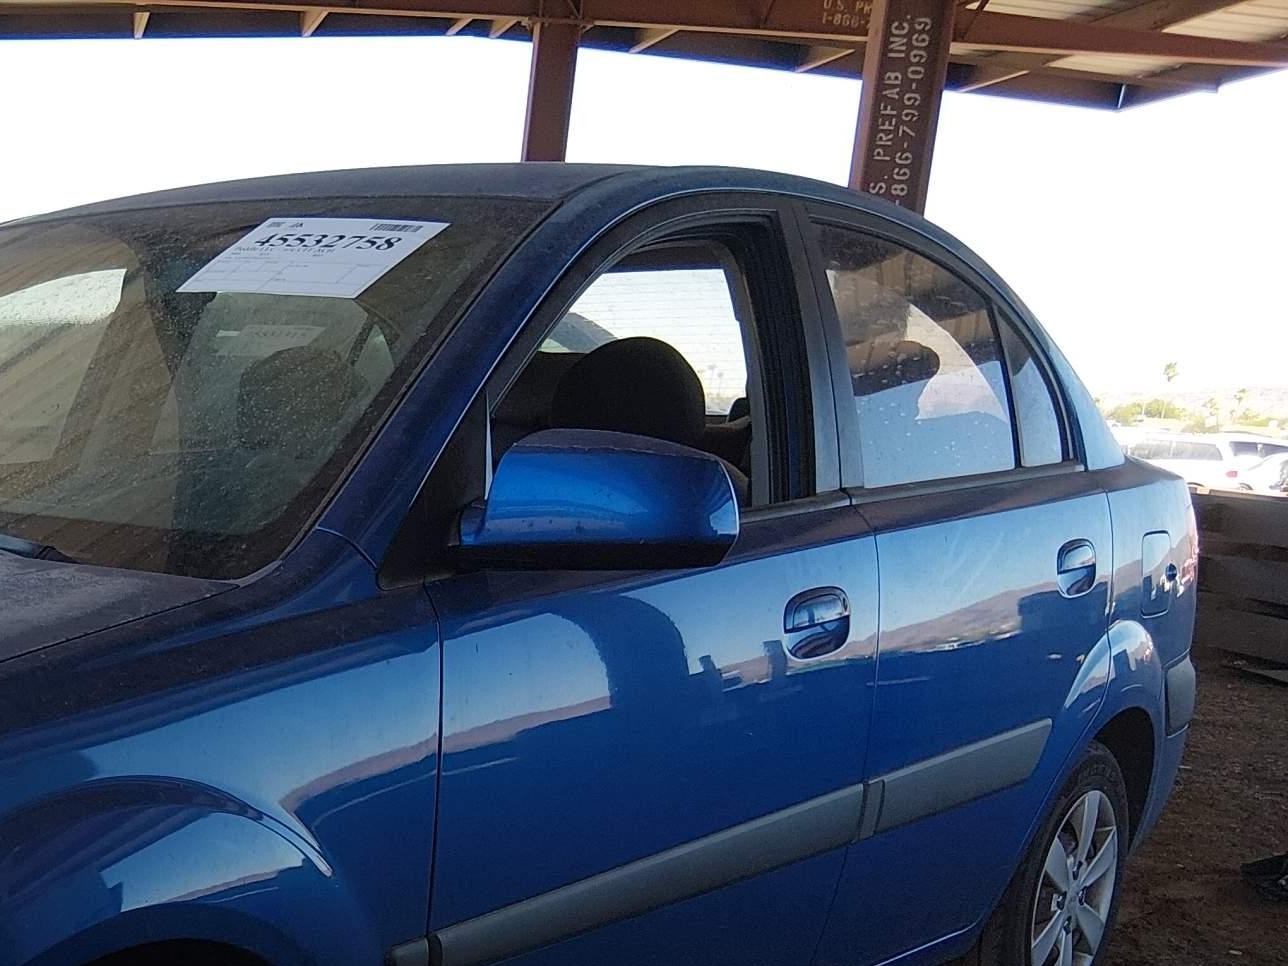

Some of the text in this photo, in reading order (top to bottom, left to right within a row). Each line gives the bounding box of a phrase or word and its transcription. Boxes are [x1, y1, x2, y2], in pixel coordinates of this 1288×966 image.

[873, 71, 902, 161] PREFAB
[888, 14, 911, 58] INC.
[254, 233, 403, 250] 45532758
